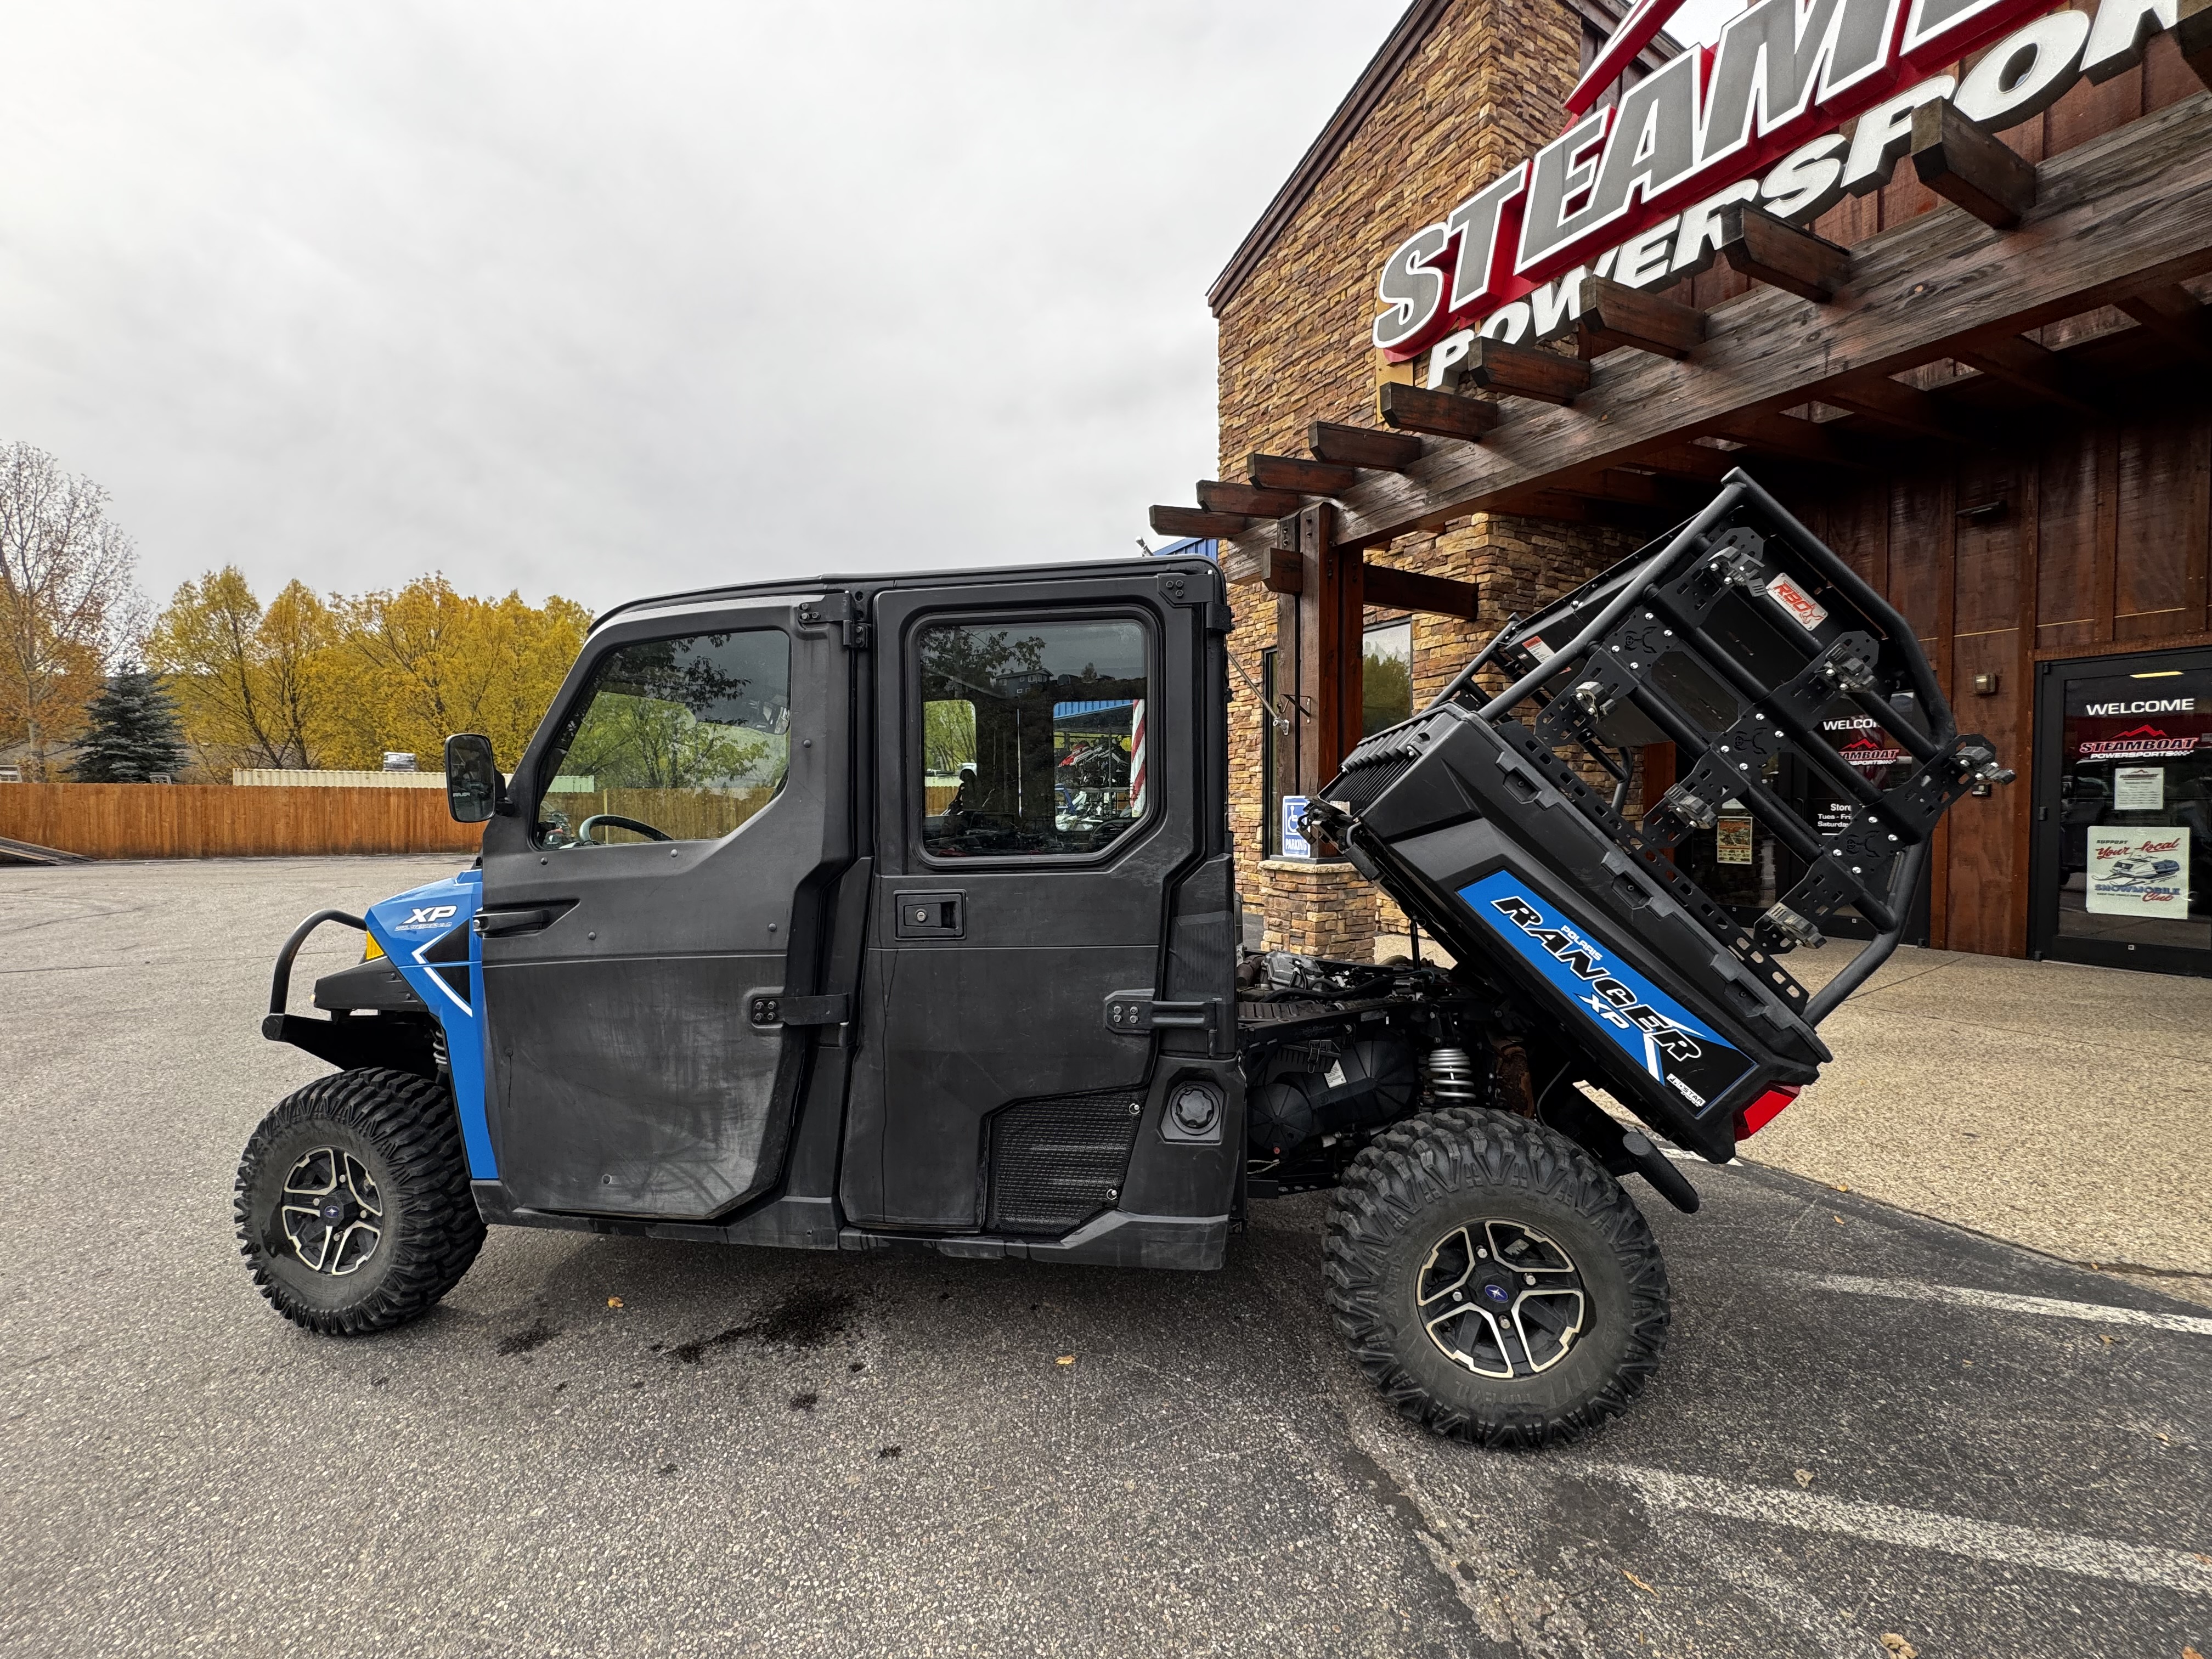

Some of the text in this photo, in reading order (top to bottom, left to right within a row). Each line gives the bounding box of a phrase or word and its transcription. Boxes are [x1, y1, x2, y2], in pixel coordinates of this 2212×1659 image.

[1373, 0, 2000, 348] STEAM
[2086, 698, 2194, 716] WELCOME
[2079, 737, 2199, 753] STEAMBOAT
[1838, 749, 1900, 760] AMBOAT
[2090, 749, 2175, 759] POWERSPORTS
[1830, 803, 1852, 811] Store
[1285, 838, 1308, 851] PARKING
[2095, 846, 2134, 860] Your
[2095, 884, 2181, 895] SNOWMOBILE
[2142, 891, 2176, 902] Club
[402, 905, 458, 925] XP
[1560, 924, 1603, 961] POLARIS
[1490, 895, 1701, 1062] RANGER
[1573, 992, 1630, 1030] XP
